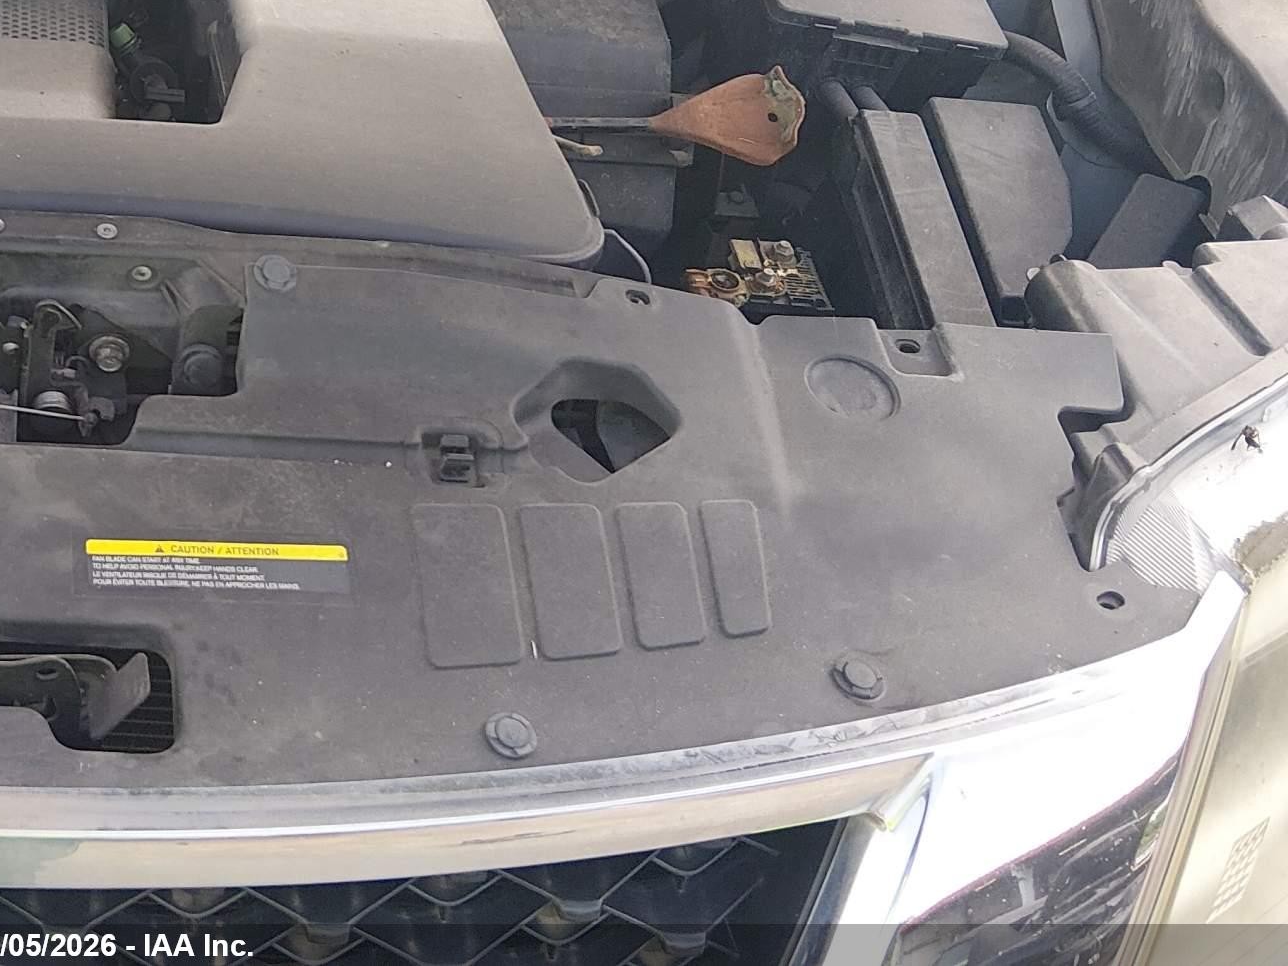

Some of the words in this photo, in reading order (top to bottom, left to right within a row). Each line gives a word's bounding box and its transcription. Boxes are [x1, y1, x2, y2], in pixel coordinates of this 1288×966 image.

[170, 545, 214, 555] CAUTION
[225, 546, 279, 556] ATTENTION
[119, 563, 138, 571] AVOID
